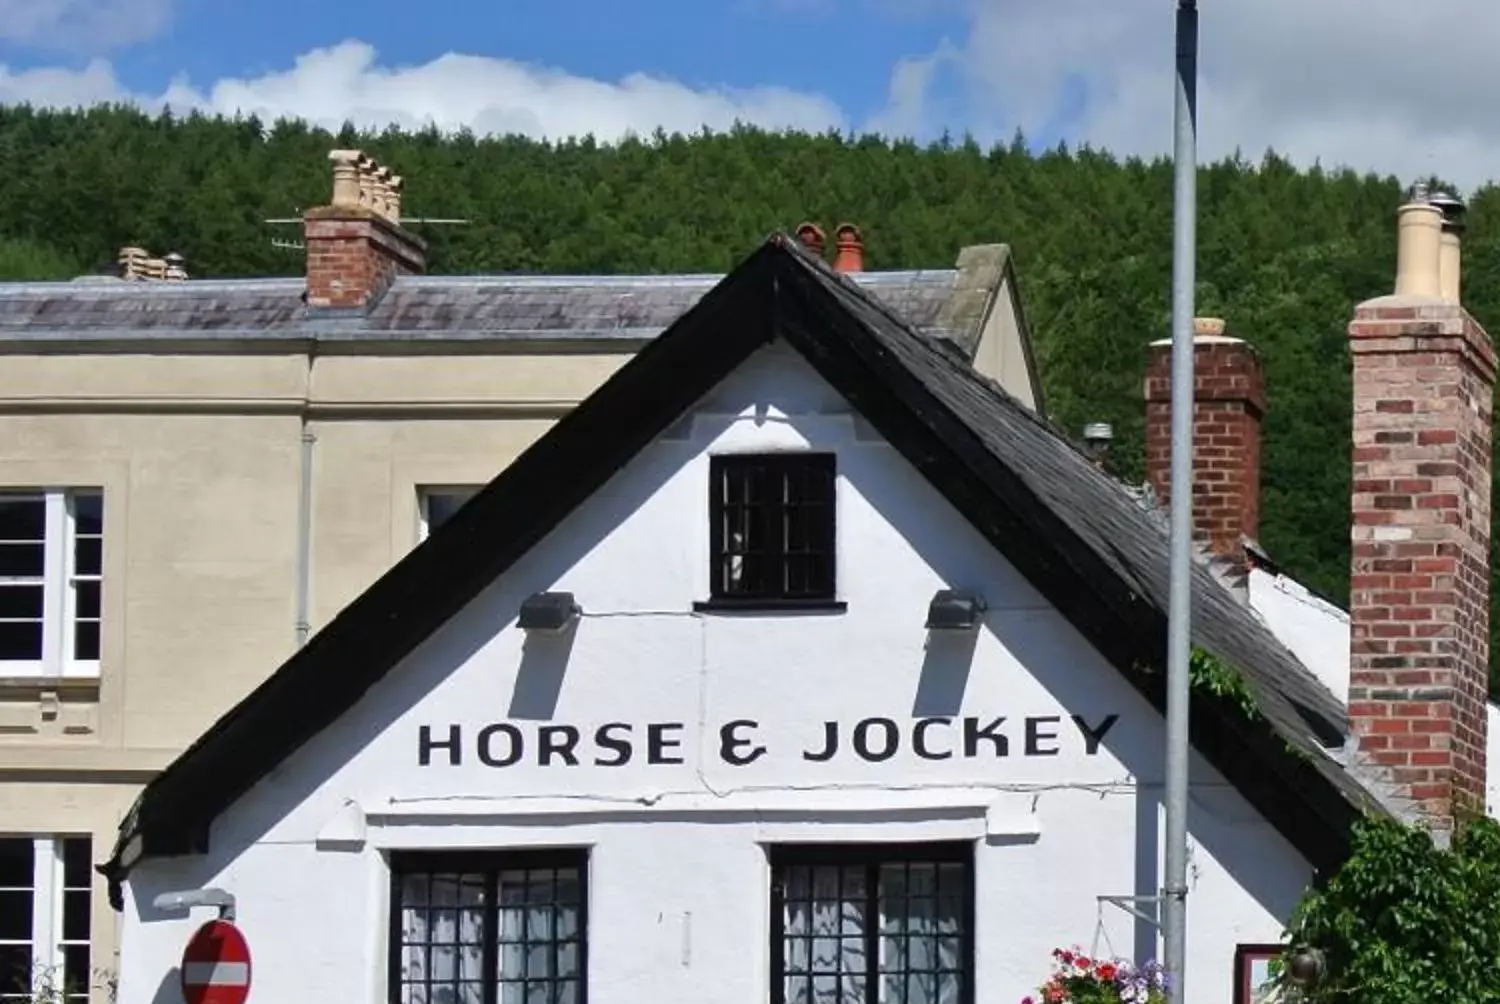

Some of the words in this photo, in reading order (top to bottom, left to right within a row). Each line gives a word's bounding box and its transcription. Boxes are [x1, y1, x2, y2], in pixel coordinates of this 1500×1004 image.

[419, 723, 684, 767] HORSE
[720, 720, 767, 767] &
[802, 714, 1121, 763] JOCKEY
